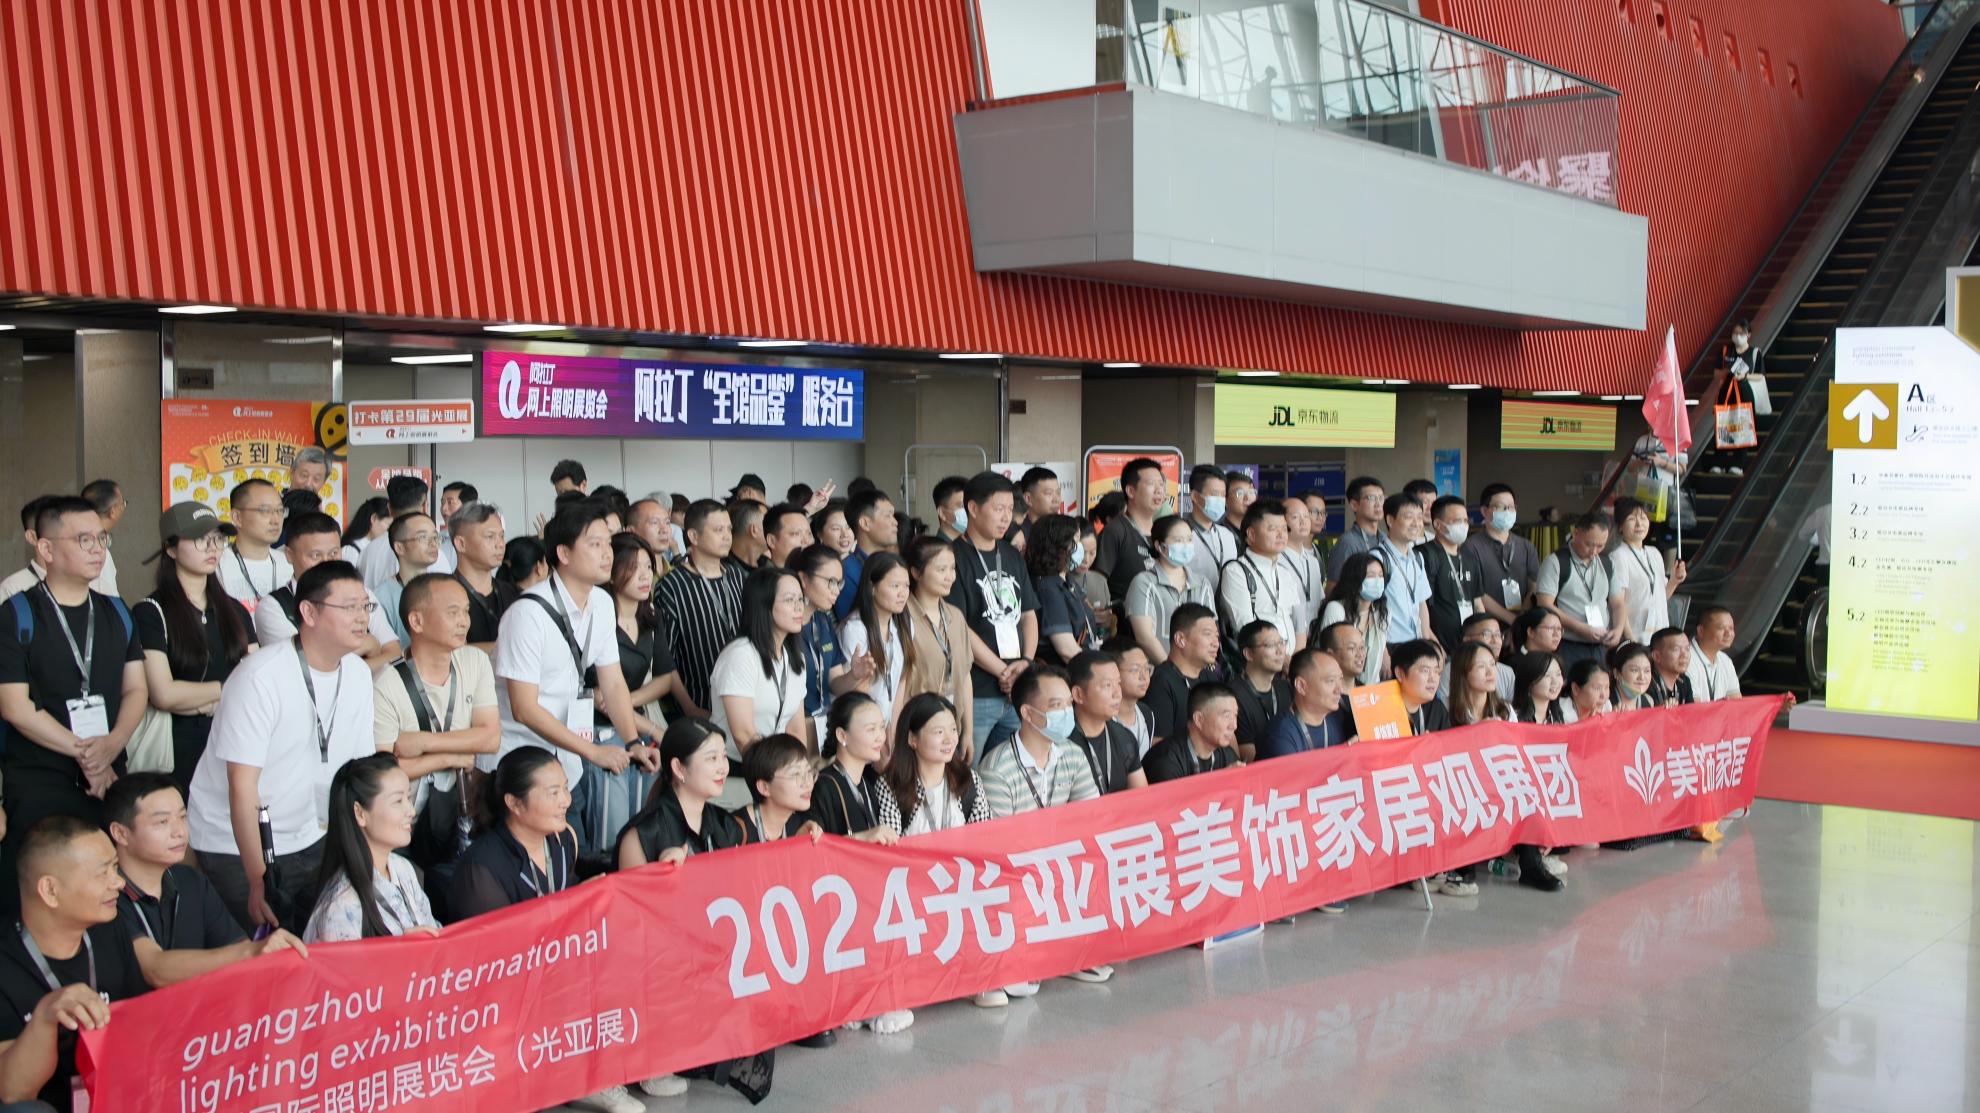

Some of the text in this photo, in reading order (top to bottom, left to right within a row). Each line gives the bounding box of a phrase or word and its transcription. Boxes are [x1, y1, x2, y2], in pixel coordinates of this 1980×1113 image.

[529, 361, 556, 385] 阿拉丁
[526, 386, 608, 420] 网上照明展览会
[1268, 405, 1339, 427] JDL 京东物流
[220, 441, 298, 468] 签到墙
[1850, 473, 1867, 486] 1.2
[1850, 502, 1869, 516] 2.2
[1850, 526, 1868, 540] 3.2
[1849, 555, 1867, 568] 4.2
[1847, 608, 1865, 622] 5.2
[1666, 736, 1752, 800] 美饰家居
[181, 918, 609, 1072] guangzhou international
[180, 1002, 500, 1113] lighting exhibition
